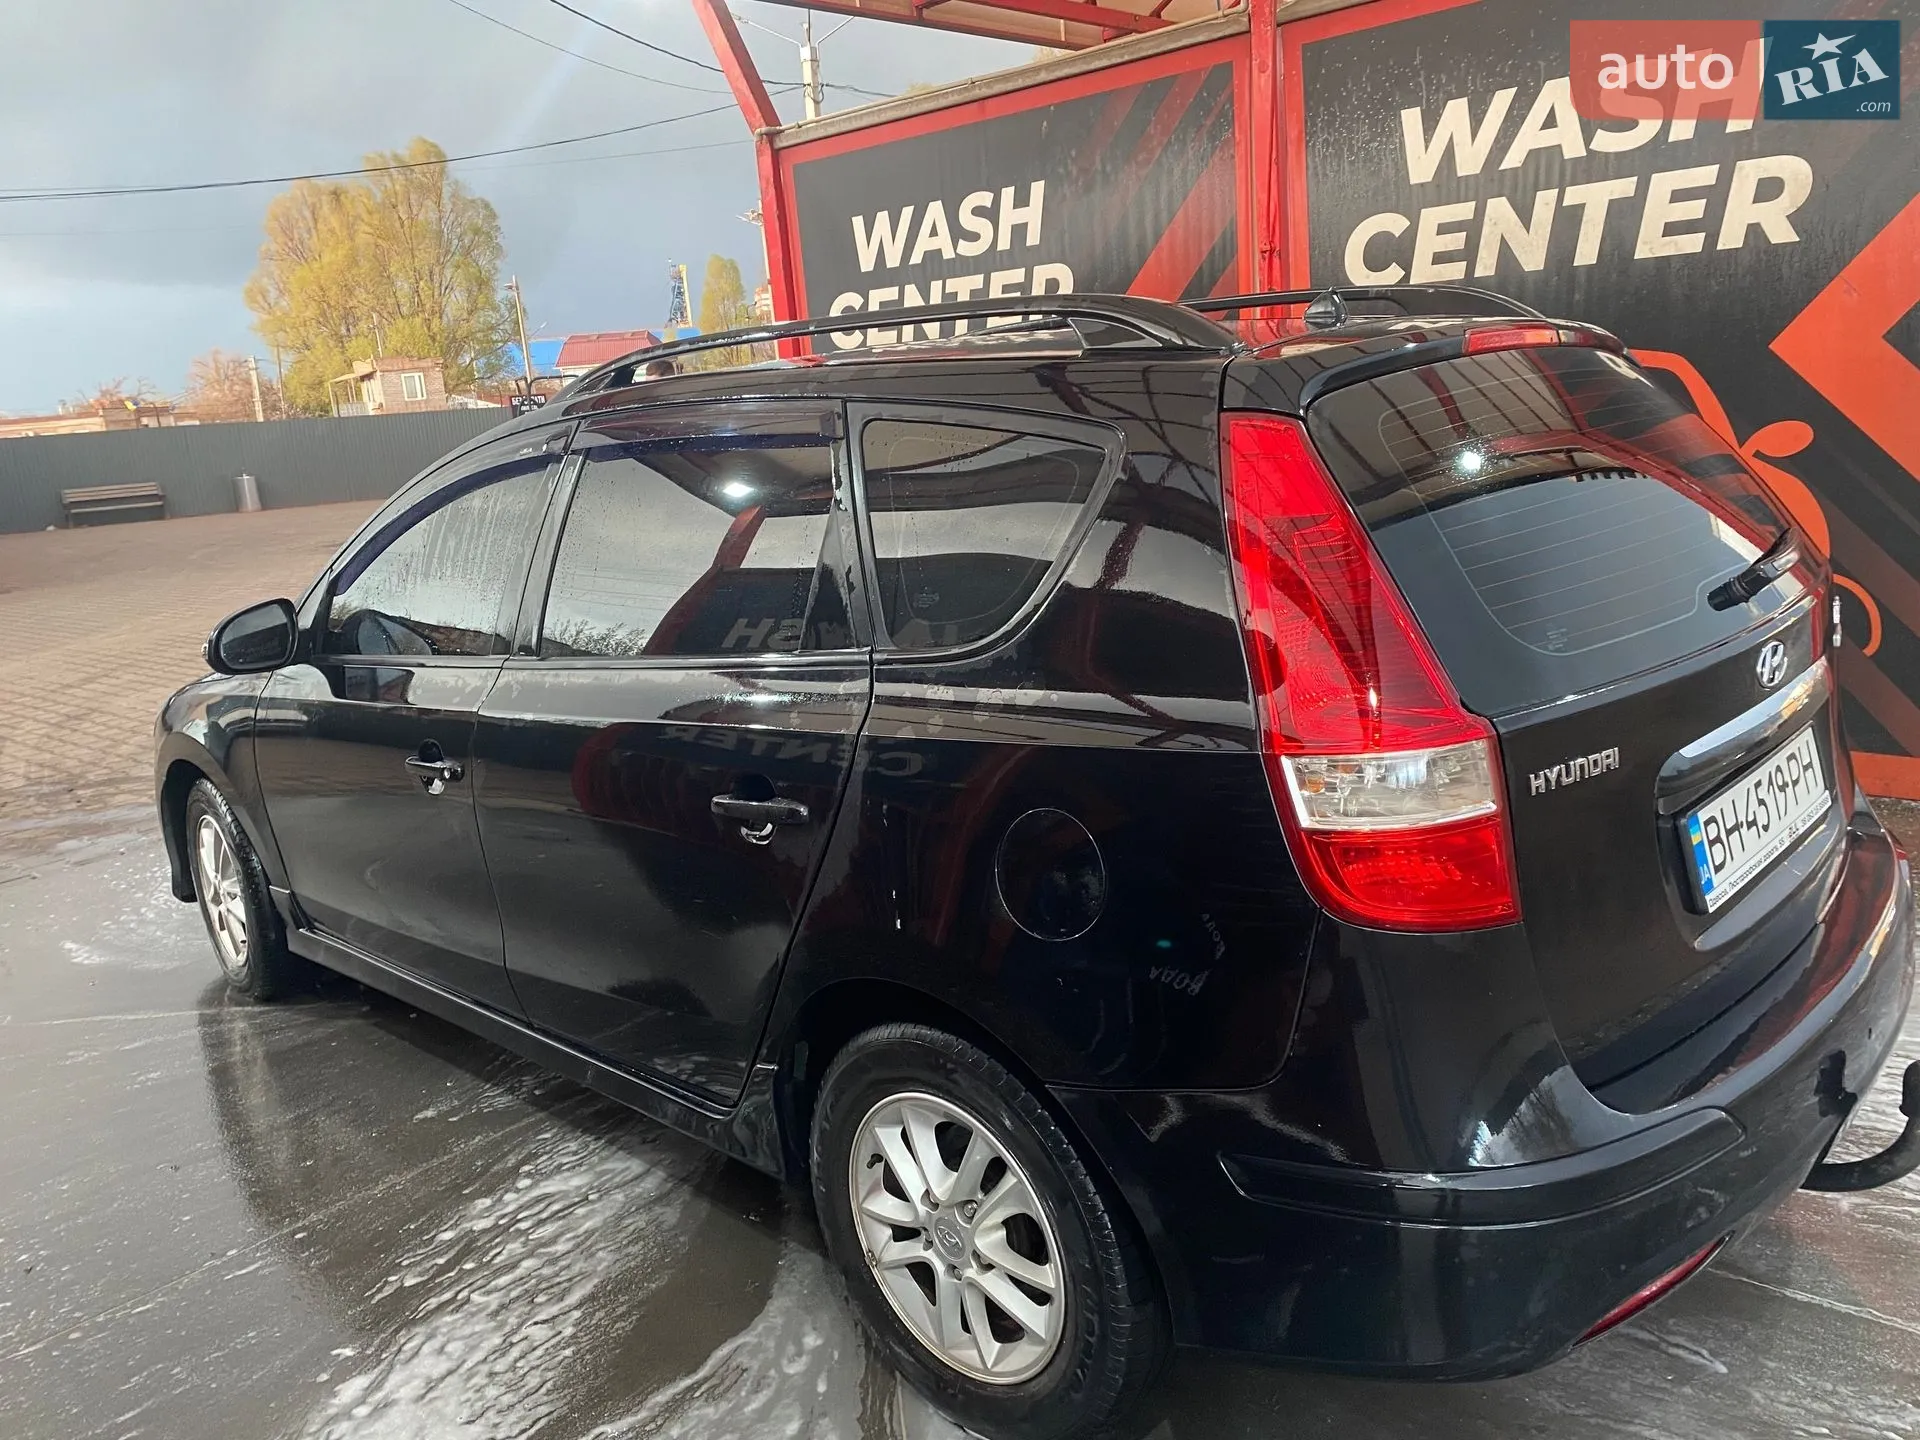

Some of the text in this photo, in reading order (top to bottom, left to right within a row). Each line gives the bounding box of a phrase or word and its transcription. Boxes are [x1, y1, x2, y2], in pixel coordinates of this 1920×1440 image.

[1400, 36, 1774, 186] WASH
[851, 179, 1046, 272] WASH
[1344, 154, 1814, 287] CENTER
[1529, 747, 1620, 796] HYUNDAI
